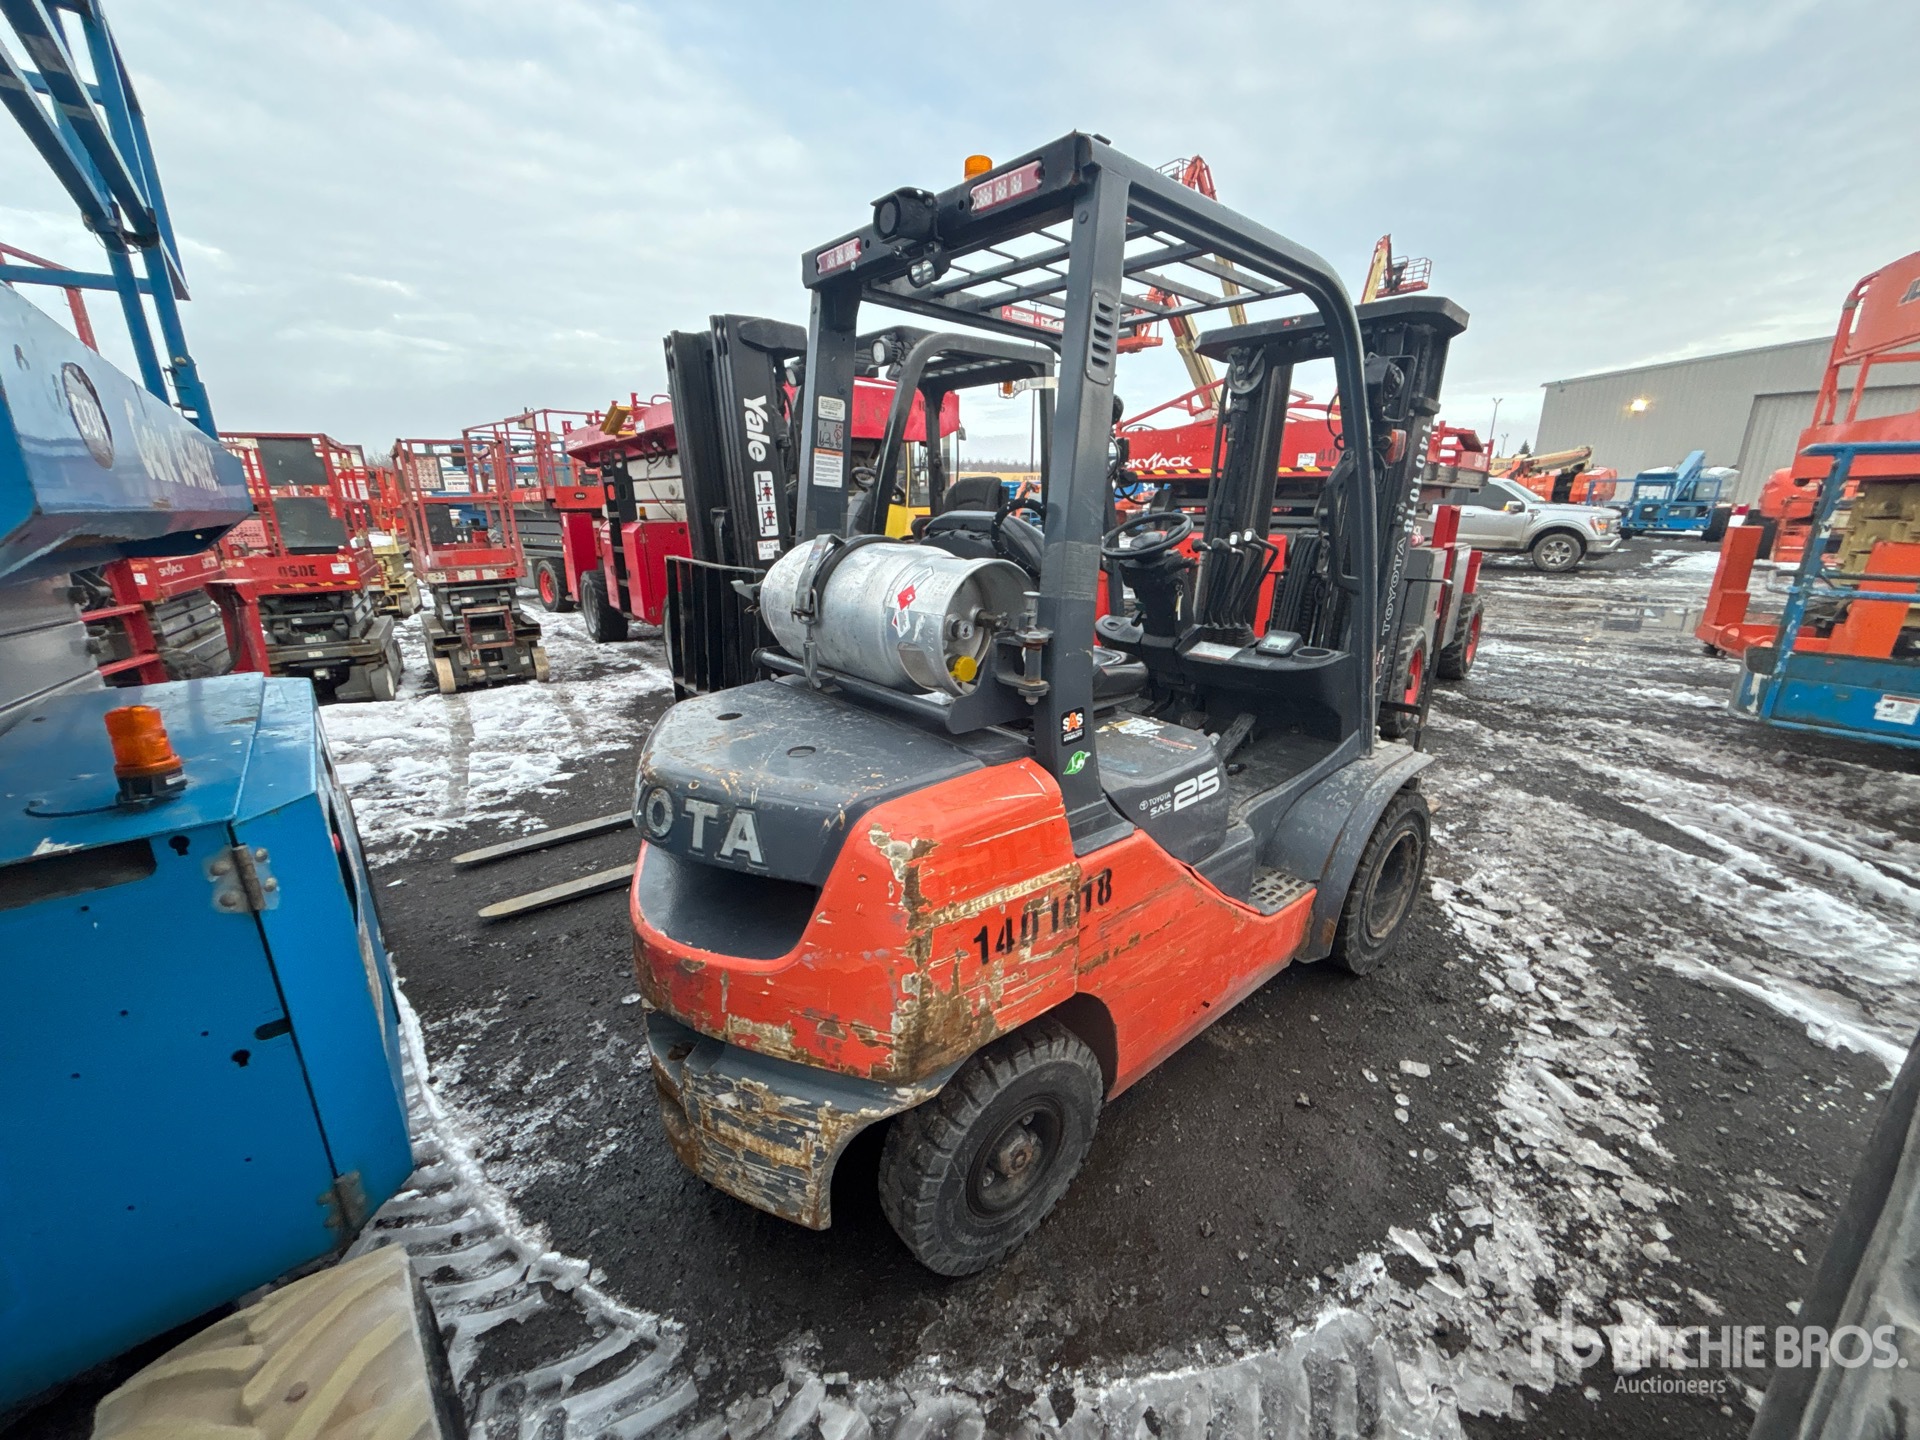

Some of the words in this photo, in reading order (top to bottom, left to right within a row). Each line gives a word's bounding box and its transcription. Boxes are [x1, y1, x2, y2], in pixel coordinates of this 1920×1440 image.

[743, 395, 771, 462] Yale
[1124, 452, 1193, 470] SKYJACK
[1381, 536, 1407, 636] TOYOTA
[1062, 711, 1084, 732] SAS
[1148, 791, 1171, 806] TOYOTA
[1174, 767, 1220, 812] 25
[1149, 800, 1171, 816] SAS
[643, 786, 764, 864] OTA
